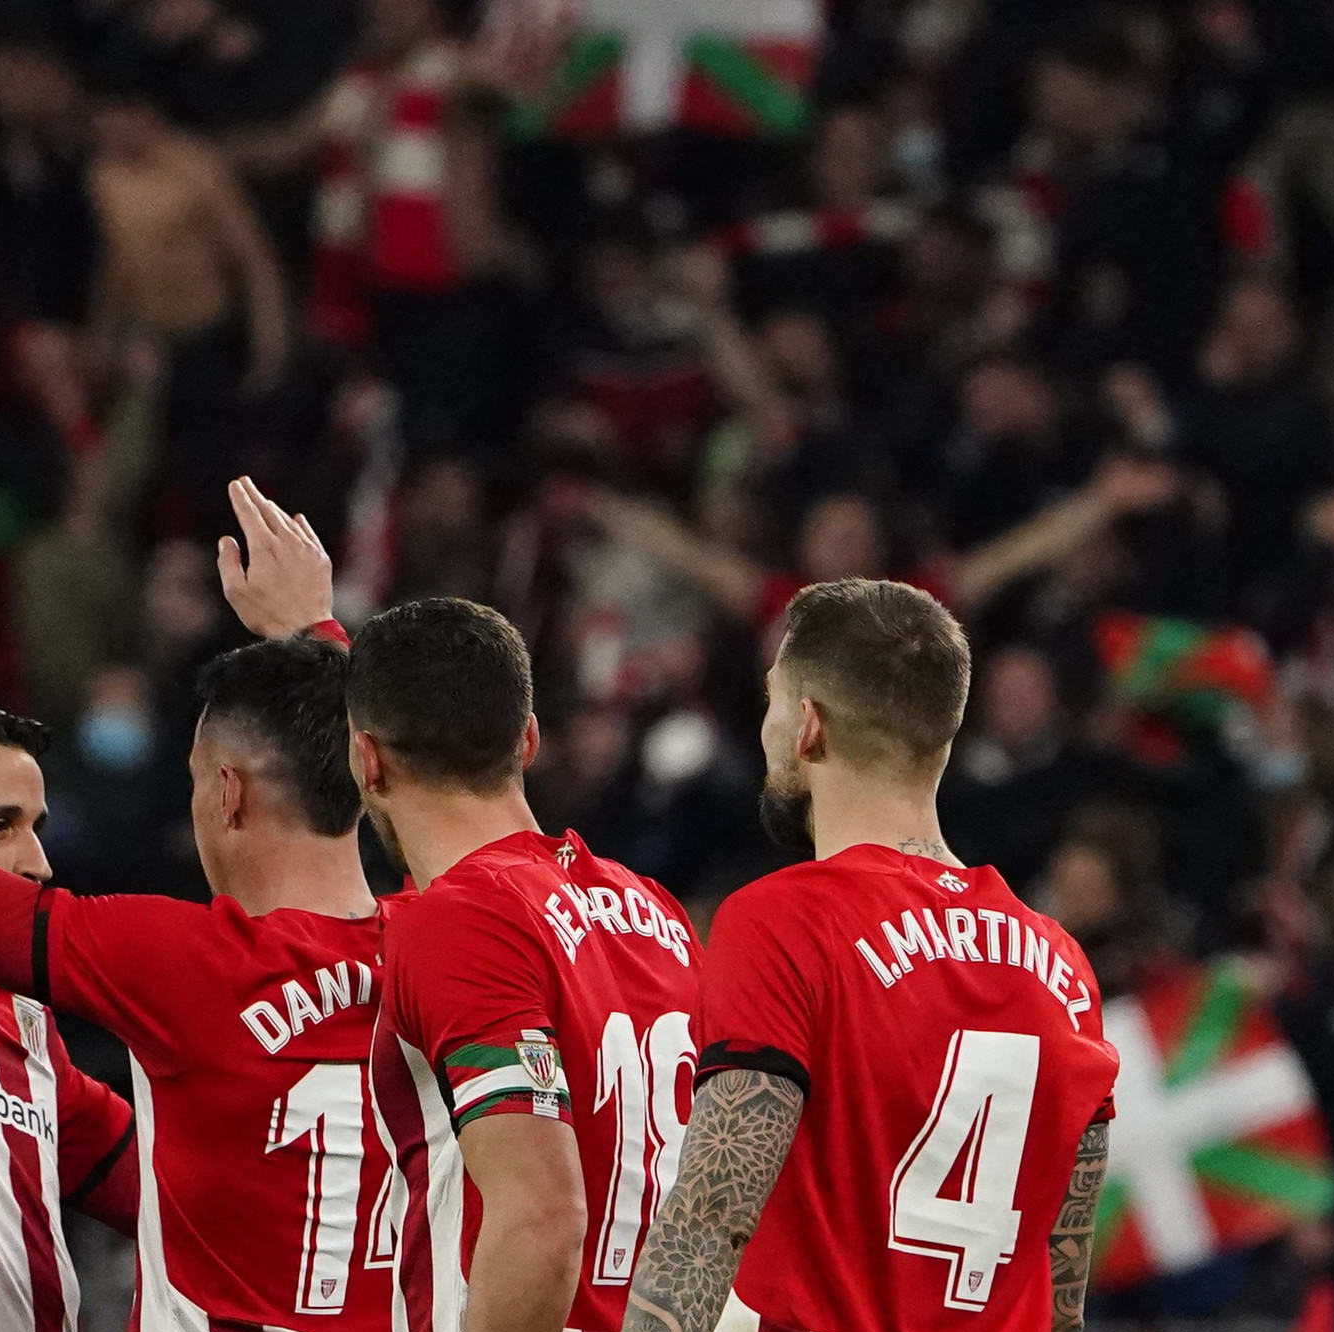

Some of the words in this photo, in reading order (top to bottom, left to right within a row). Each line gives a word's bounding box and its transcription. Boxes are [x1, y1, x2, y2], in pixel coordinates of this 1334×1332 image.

[239, 960, 372, 1055] DANI
[854, 907, 1092, 1033] I.MARTINEZ
[888, 1029, 1041, 1312] 4
